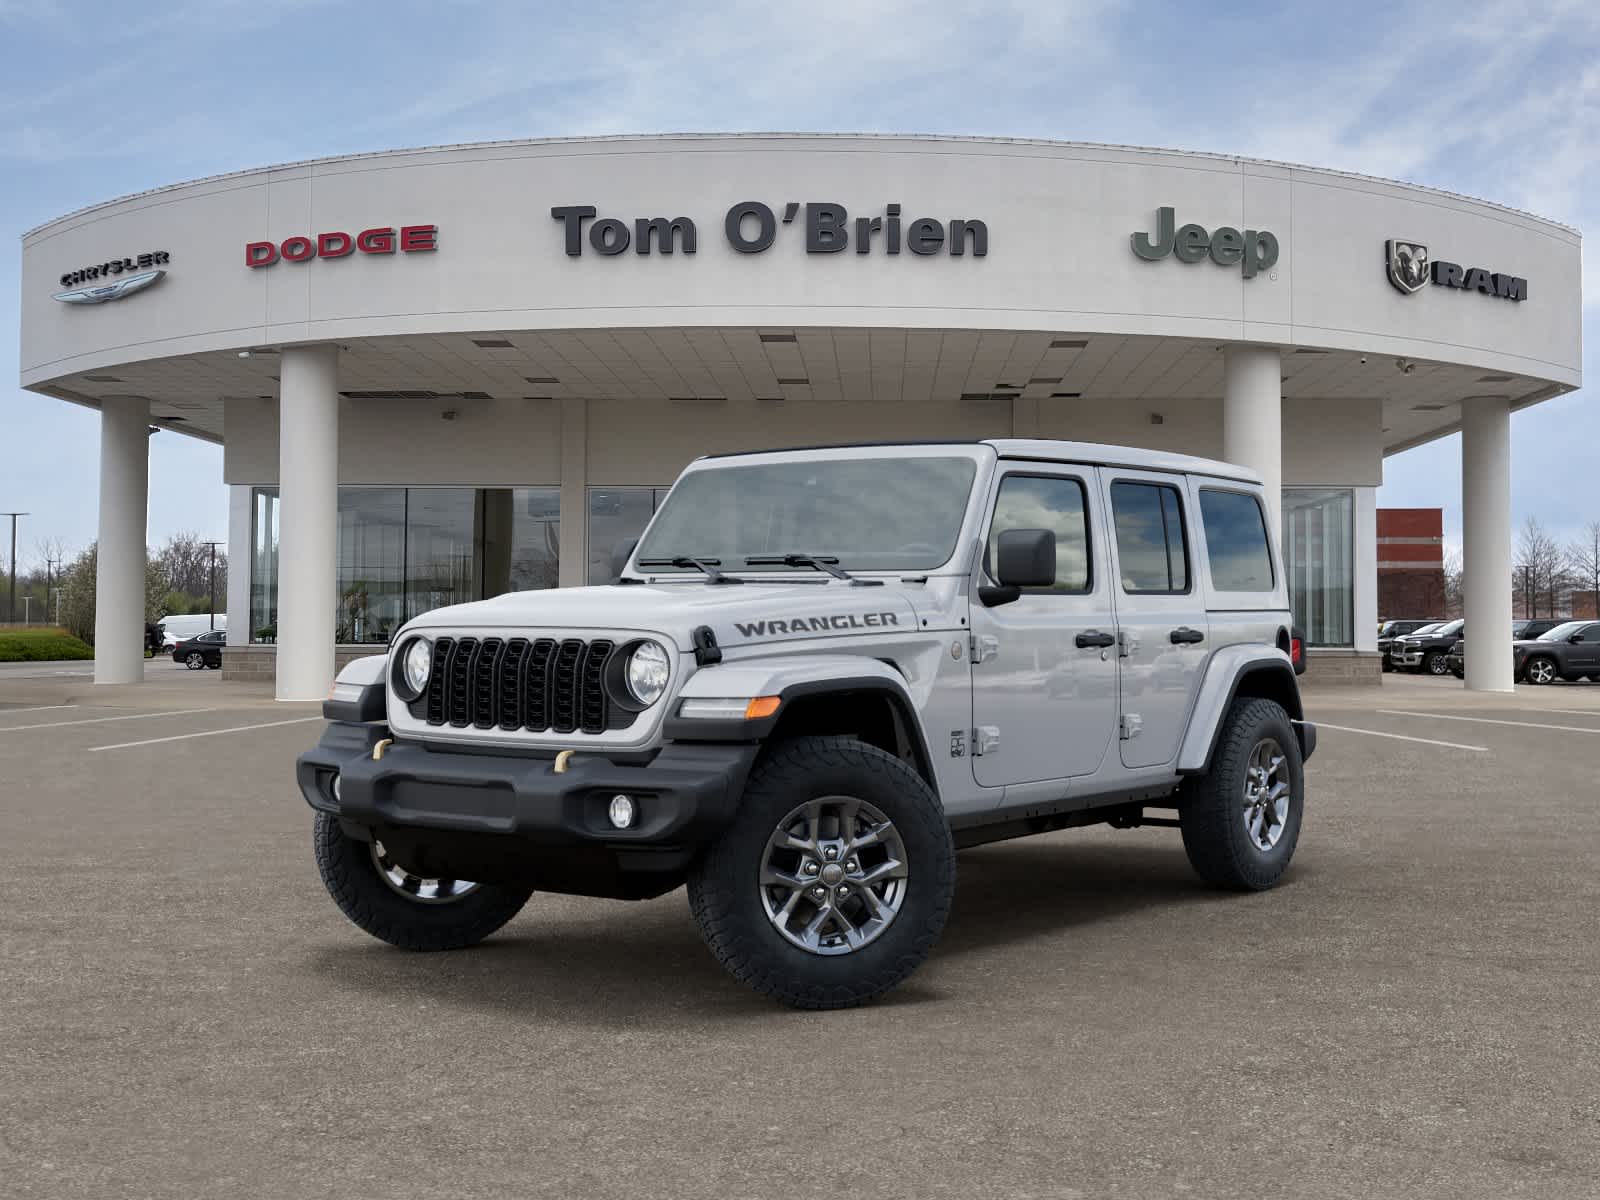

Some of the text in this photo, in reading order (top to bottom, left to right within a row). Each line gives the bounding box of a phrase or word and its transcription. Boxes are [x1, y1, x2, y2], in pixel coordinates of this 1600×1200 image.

[245, 224, 438, 269] DODGE
[551, 201, 989, 256] Tom O'Brien
[1130, 207, 1280, 279] Jeep
[60, 251, 170, 286] CHRYSLER
[1431, 261, 1527, 301] RAM
[734, 612, 899, 638] WRANGLER
